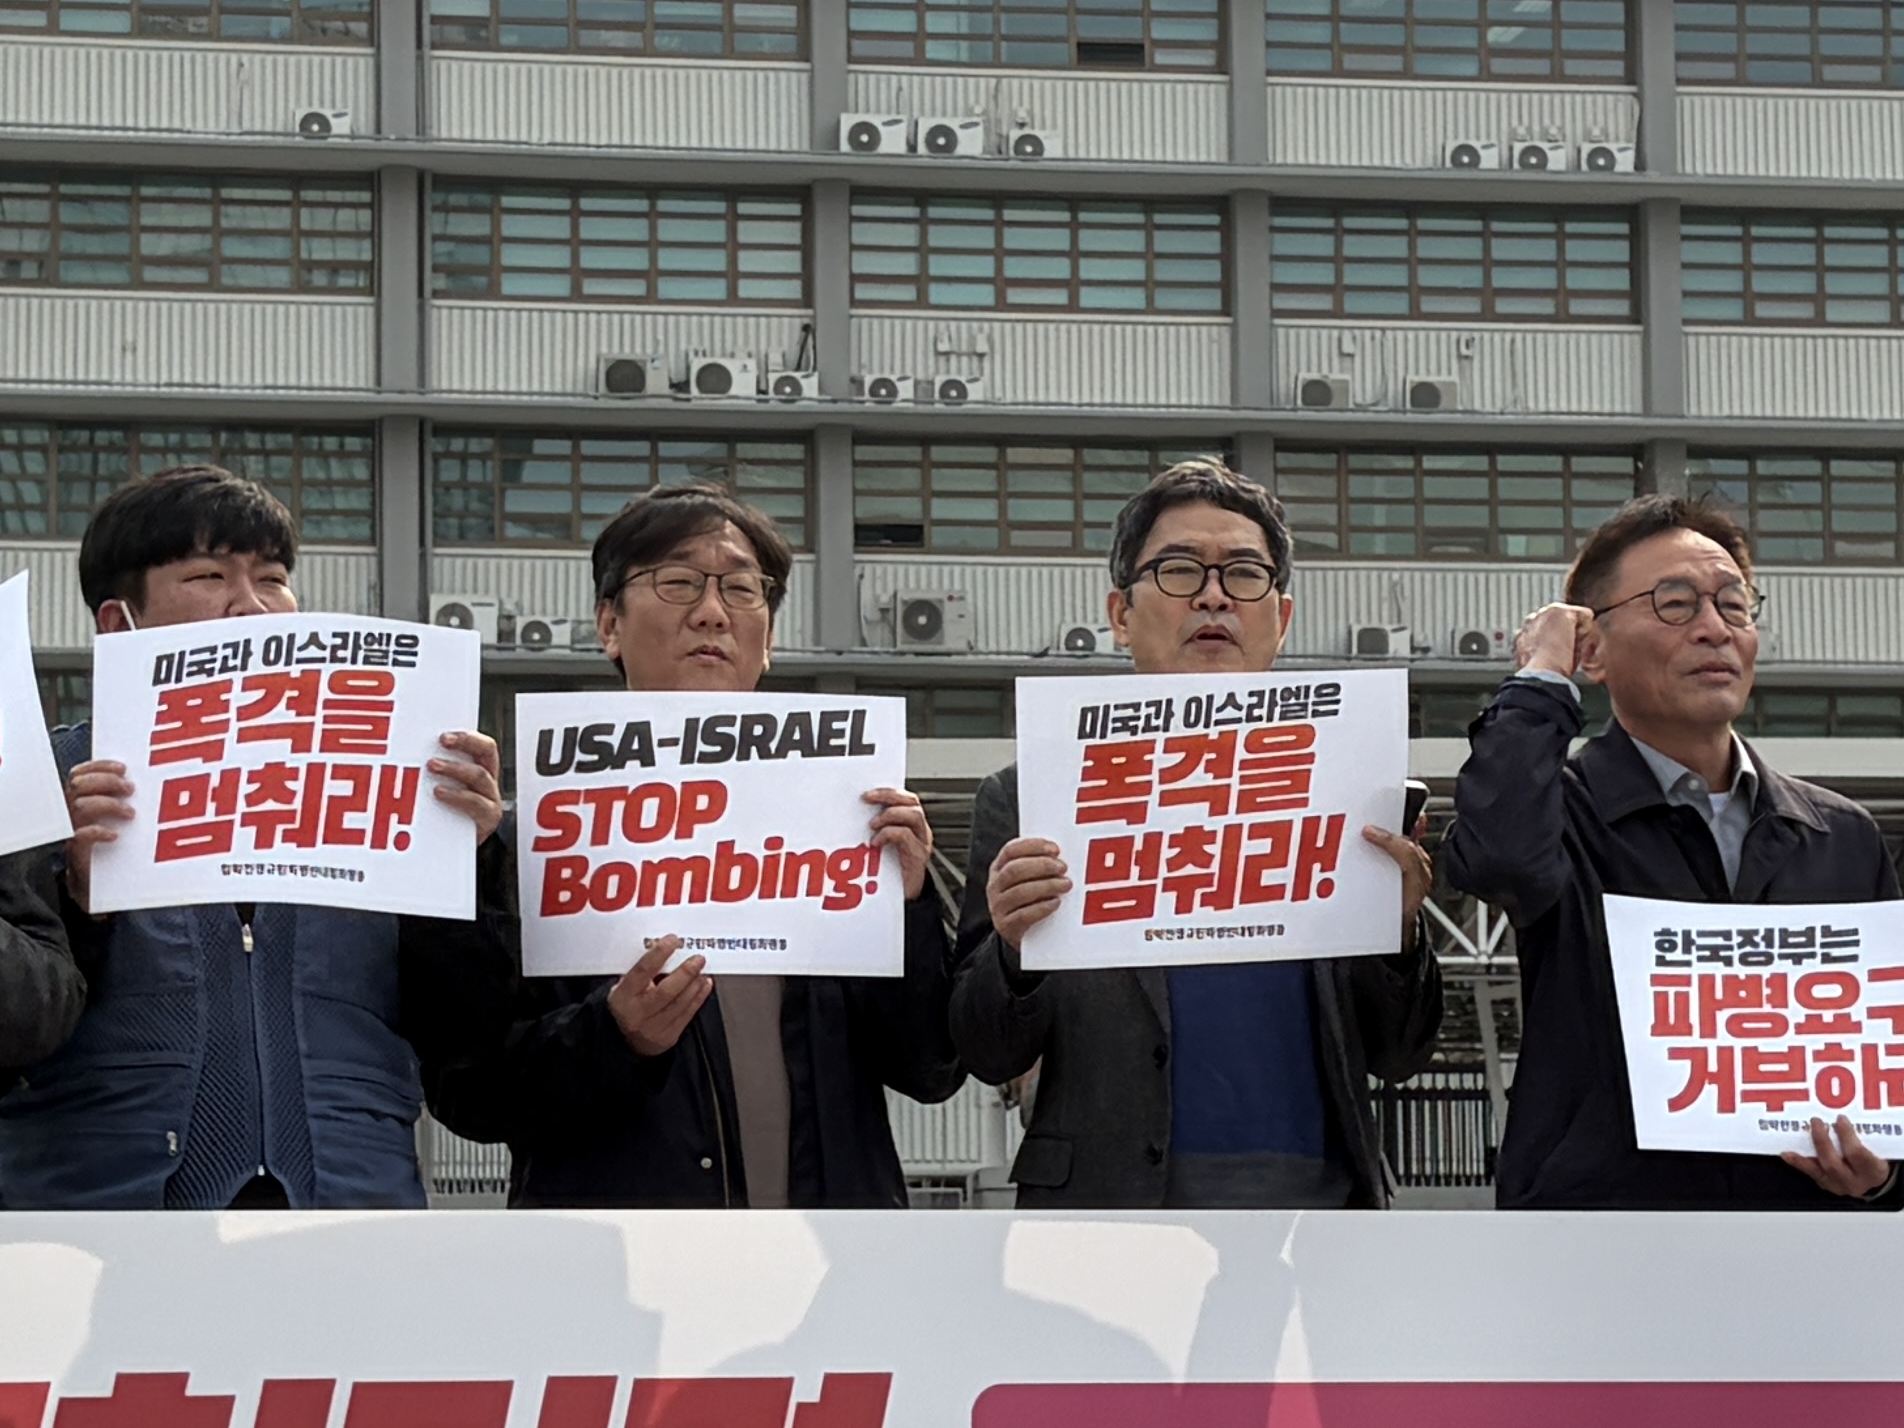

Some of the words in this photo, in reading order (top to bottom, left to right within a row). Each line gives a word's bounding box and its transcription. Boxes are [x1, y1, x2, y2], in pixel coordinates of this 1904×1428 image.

[152, 638, 253, 687] 미국과
[262, 631, 420, 669] 이스라엘은
[149, 668, 395, 766] 폭격을
[535, 709, 876, 777] USA-ISRAEL
[1077, 704, 1174, 740] 미국과
[1183, 682, 1342, 730] 이스라엘은
[154, 761, 420, 863] 멈춰라!
[1075, 723, 1316, 825] 폭격을
[532, 779, 728, 852] STOP
[540, 836, 881, 917] Bombing!
[1082, 813, 1346, 925] 멈춰라!
[1654, 925, 1860, 967] 한국정부는
